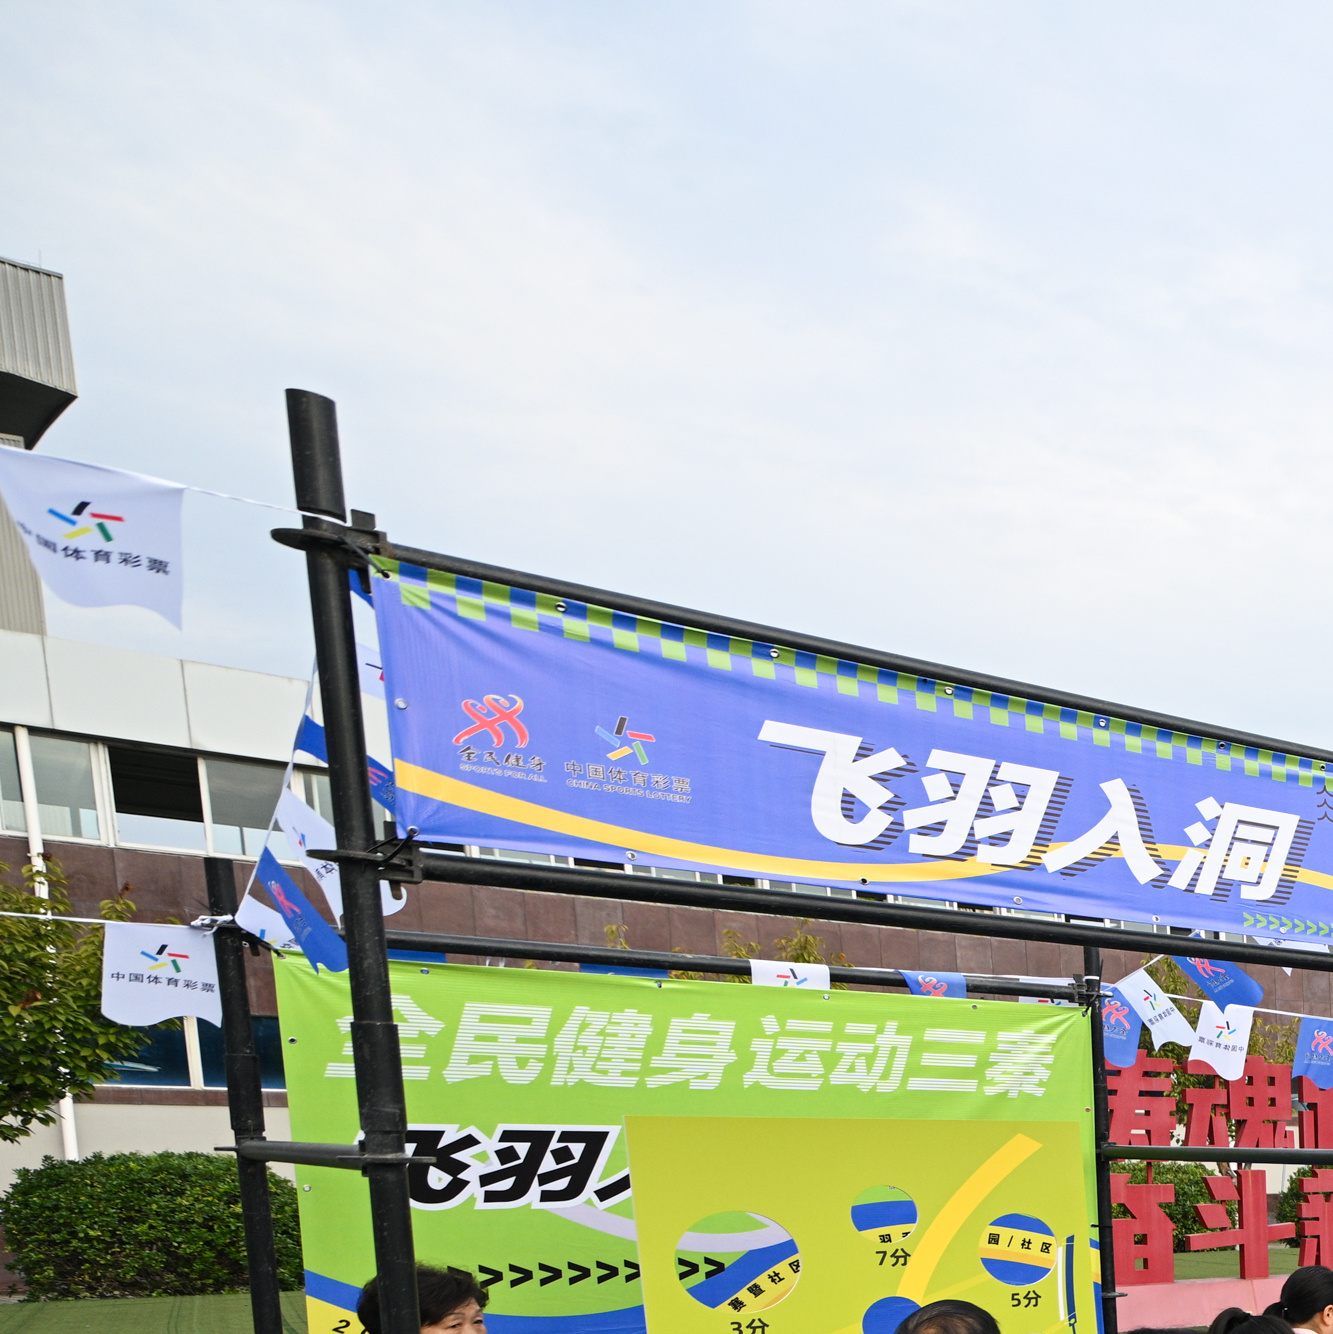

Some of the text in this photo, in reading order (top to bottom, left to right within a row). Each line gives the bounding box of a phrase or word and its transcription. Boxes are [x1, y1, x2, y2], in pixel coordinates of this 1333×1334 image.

[457, 745, 547, 772] 全民健身
[564, 760, 692, 794] 中国体育彩票
[566, 778, 692, 804] CHINA SPORTS LOTTERY
[757, 719, 1302, 901] 飞羽入洞
[111, 971, 217, 994] 中国体育彩票
[323, 994, 1056, 1099] 全民健身运动三秦
[875, 1247, 912, 1268] 7分
[1010, 1289, 1042, 1308] 5分
